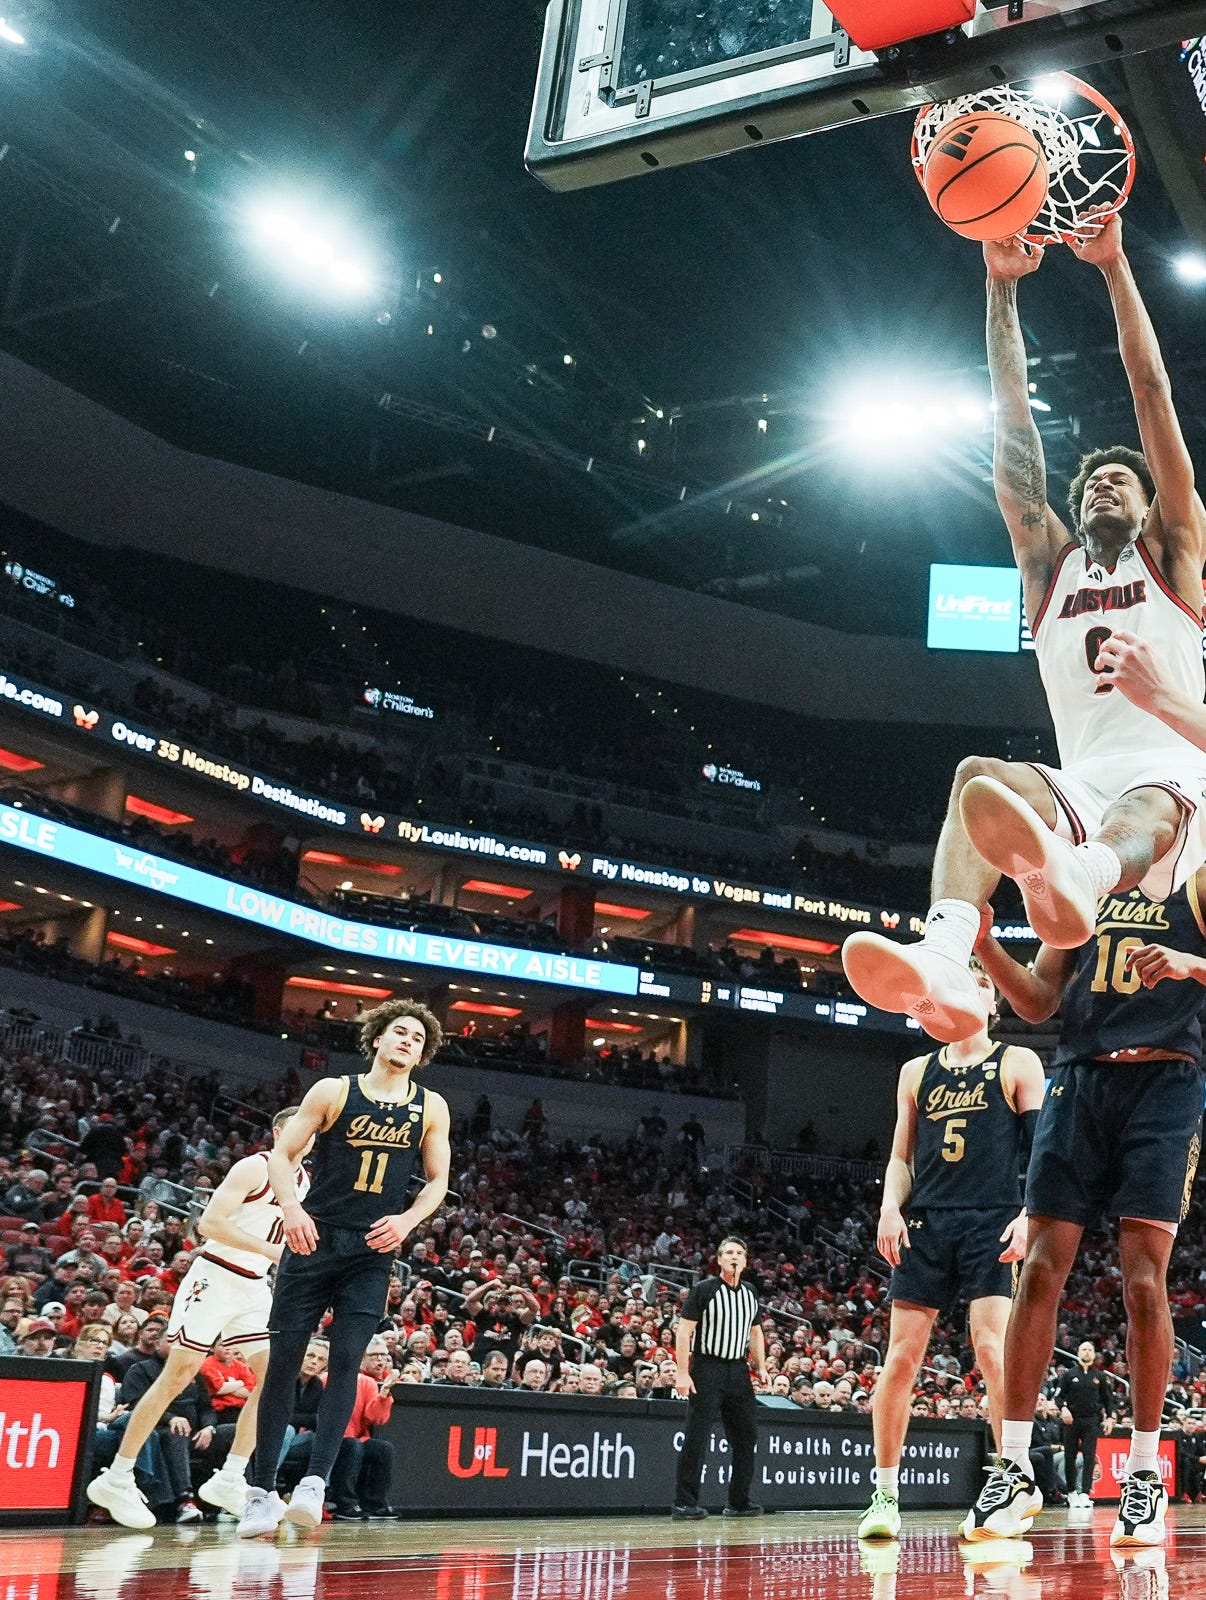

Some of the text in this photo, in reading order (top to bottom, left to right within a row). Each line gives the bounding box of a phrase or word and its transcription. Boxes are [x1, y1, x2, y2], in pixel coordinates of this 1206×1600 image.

[936, 593, 1013, 615] UniFirst
[383, 700, 434, 719] Children's
[111, 722, 347, 826] Over 35 Nonstop Destinations
[398, 821, 547, 865] flyLouisville.com
[592, 858, 870, 924] Fly Nonstop to Vegas and Fort Myers
[227, 886, 285, 924] LOW
[290, 910, 378, 951] PRICES
[387, 934, 416, 957] IN
[426, 940, 498, 971] EVERY
[524, 954, 602, 985] AISLE
[1091, 934, 1147, 995] 10
[926, 1082, 989, 1120] Irish
[345, 1114, 412, 1148] Irish
[941, 1119, 967, 1162] 5
[353, 1150, 390, 1194] 11
[520, 1431, 635, 1479] Health
[769, 1435, 831, 1456] Health
[841, 1438, 876, 1456] Car
[901, 1442, 960, 1459] rovider
[763, 1466, 860, 1485] Louisville
[870, 1467, 950, 1485] Cdinals
